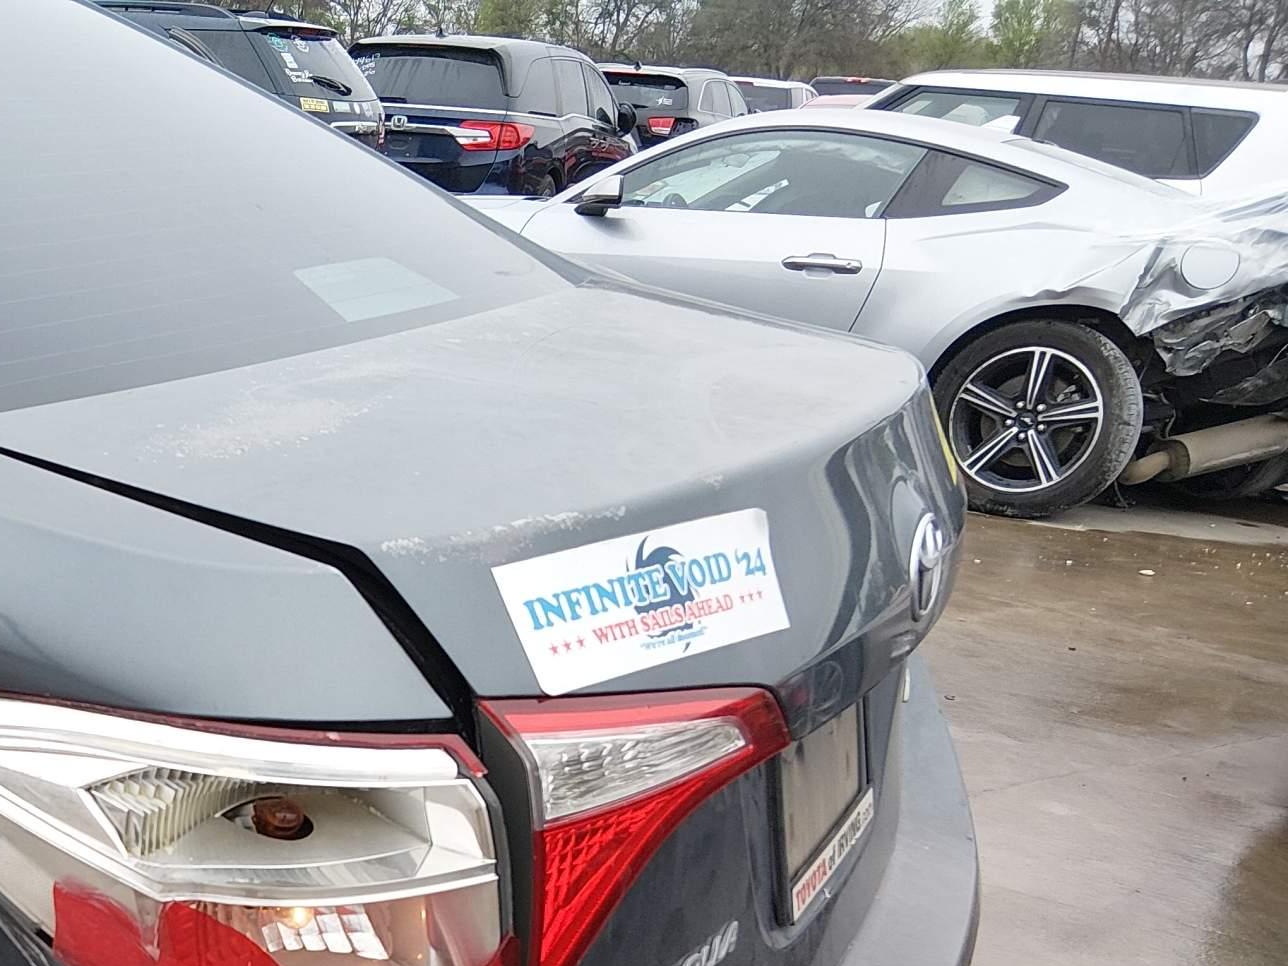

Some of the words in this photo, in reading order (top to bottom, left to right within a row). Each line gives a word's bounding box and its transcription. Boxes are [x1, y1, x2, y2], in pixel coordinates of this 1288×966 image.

[523, 567, 669, 631] INFINITE
[668, 552, 732, 594] VOID
[735, 547, 767, 577] '24
[592, 617, 640, 646] WITH
[640, 606, 684, 635] SAILS
[684, 594, 734, 622] AHEAD
[795, 858, 829, 912] TOYOTA
[837, 810, 862, 860] IRVING
